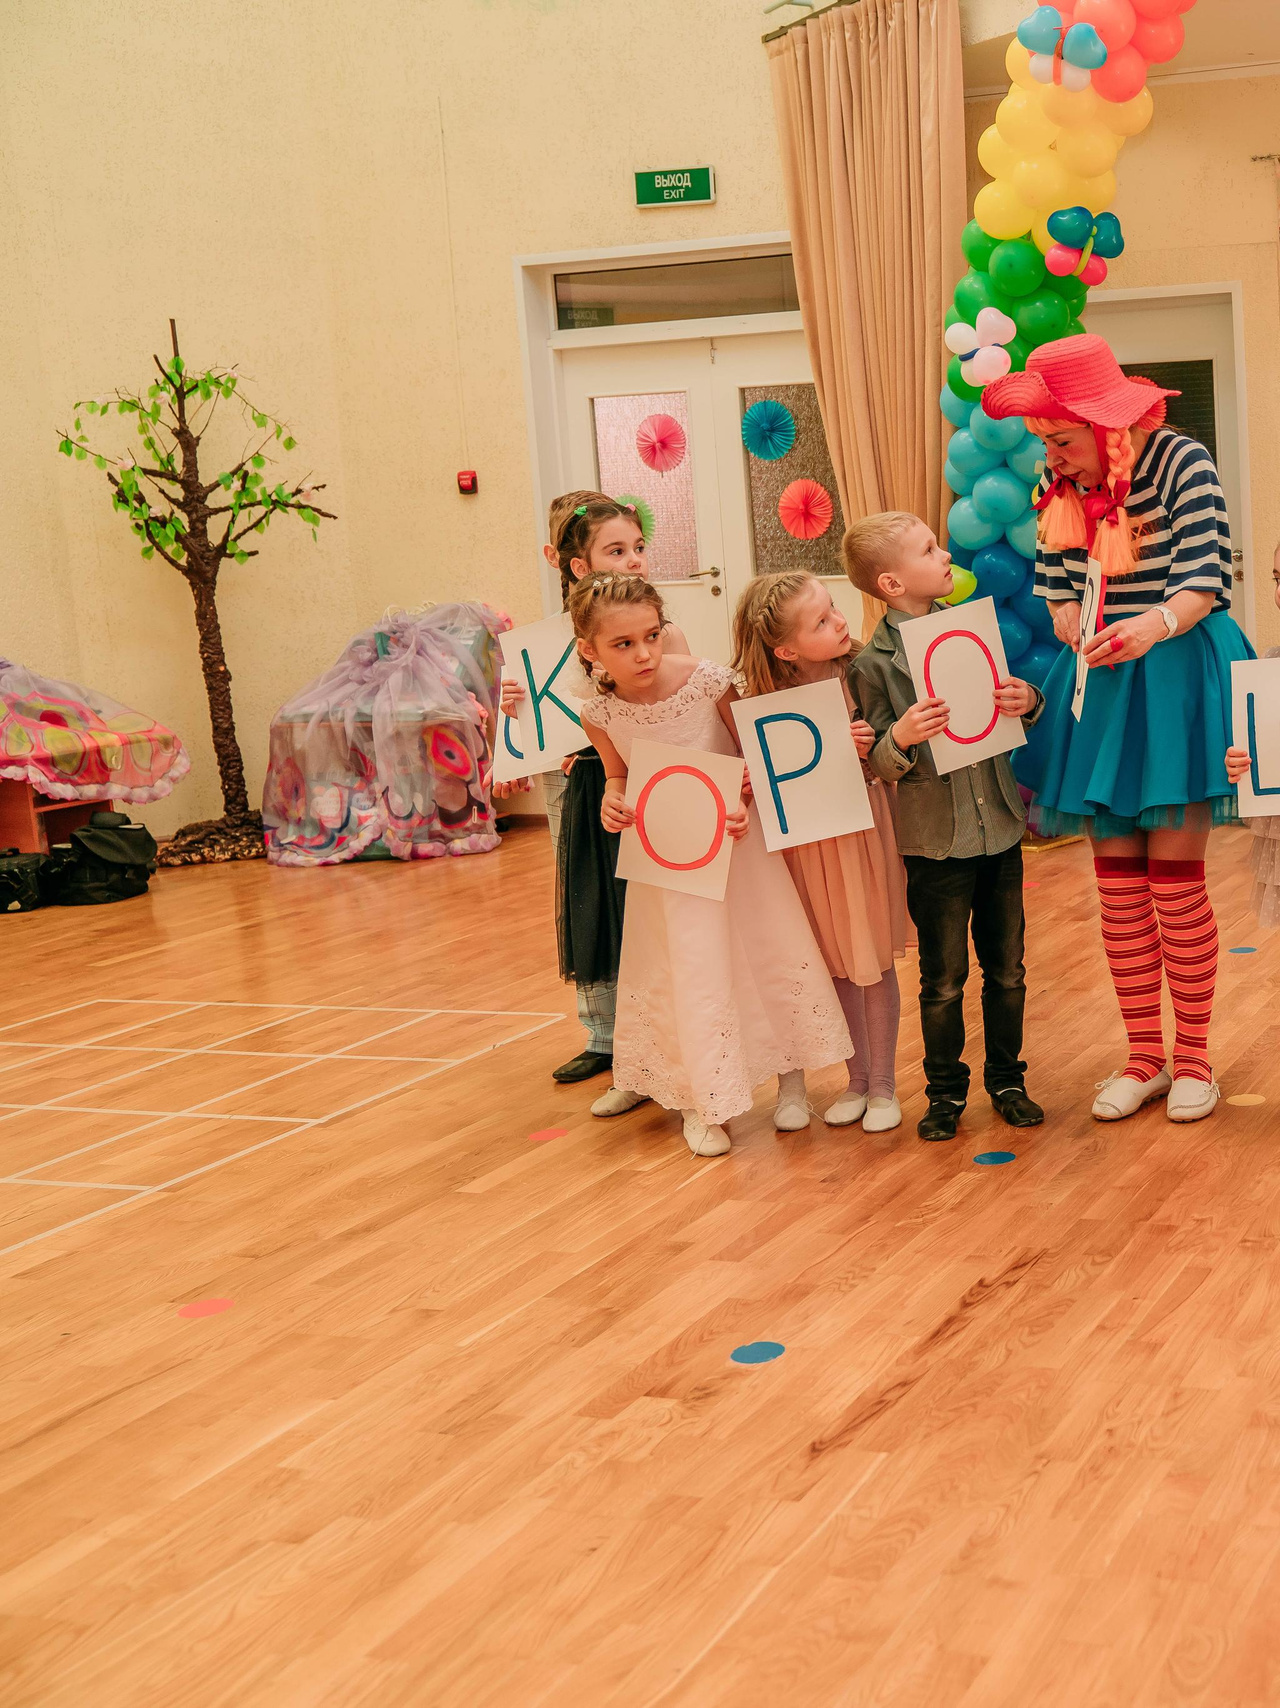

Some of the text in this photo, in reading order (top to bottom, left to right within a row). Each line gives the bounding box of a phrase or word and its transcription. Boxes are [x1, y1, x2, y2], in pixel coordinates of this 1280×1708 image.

[654, 172, 691, 188] ВЫХОД
[663, 188, 685, 200] EXIT
[521, 637, 585, 752] К
[635, 765, 727, 871] О
[754, 712, 823, 835] Р
